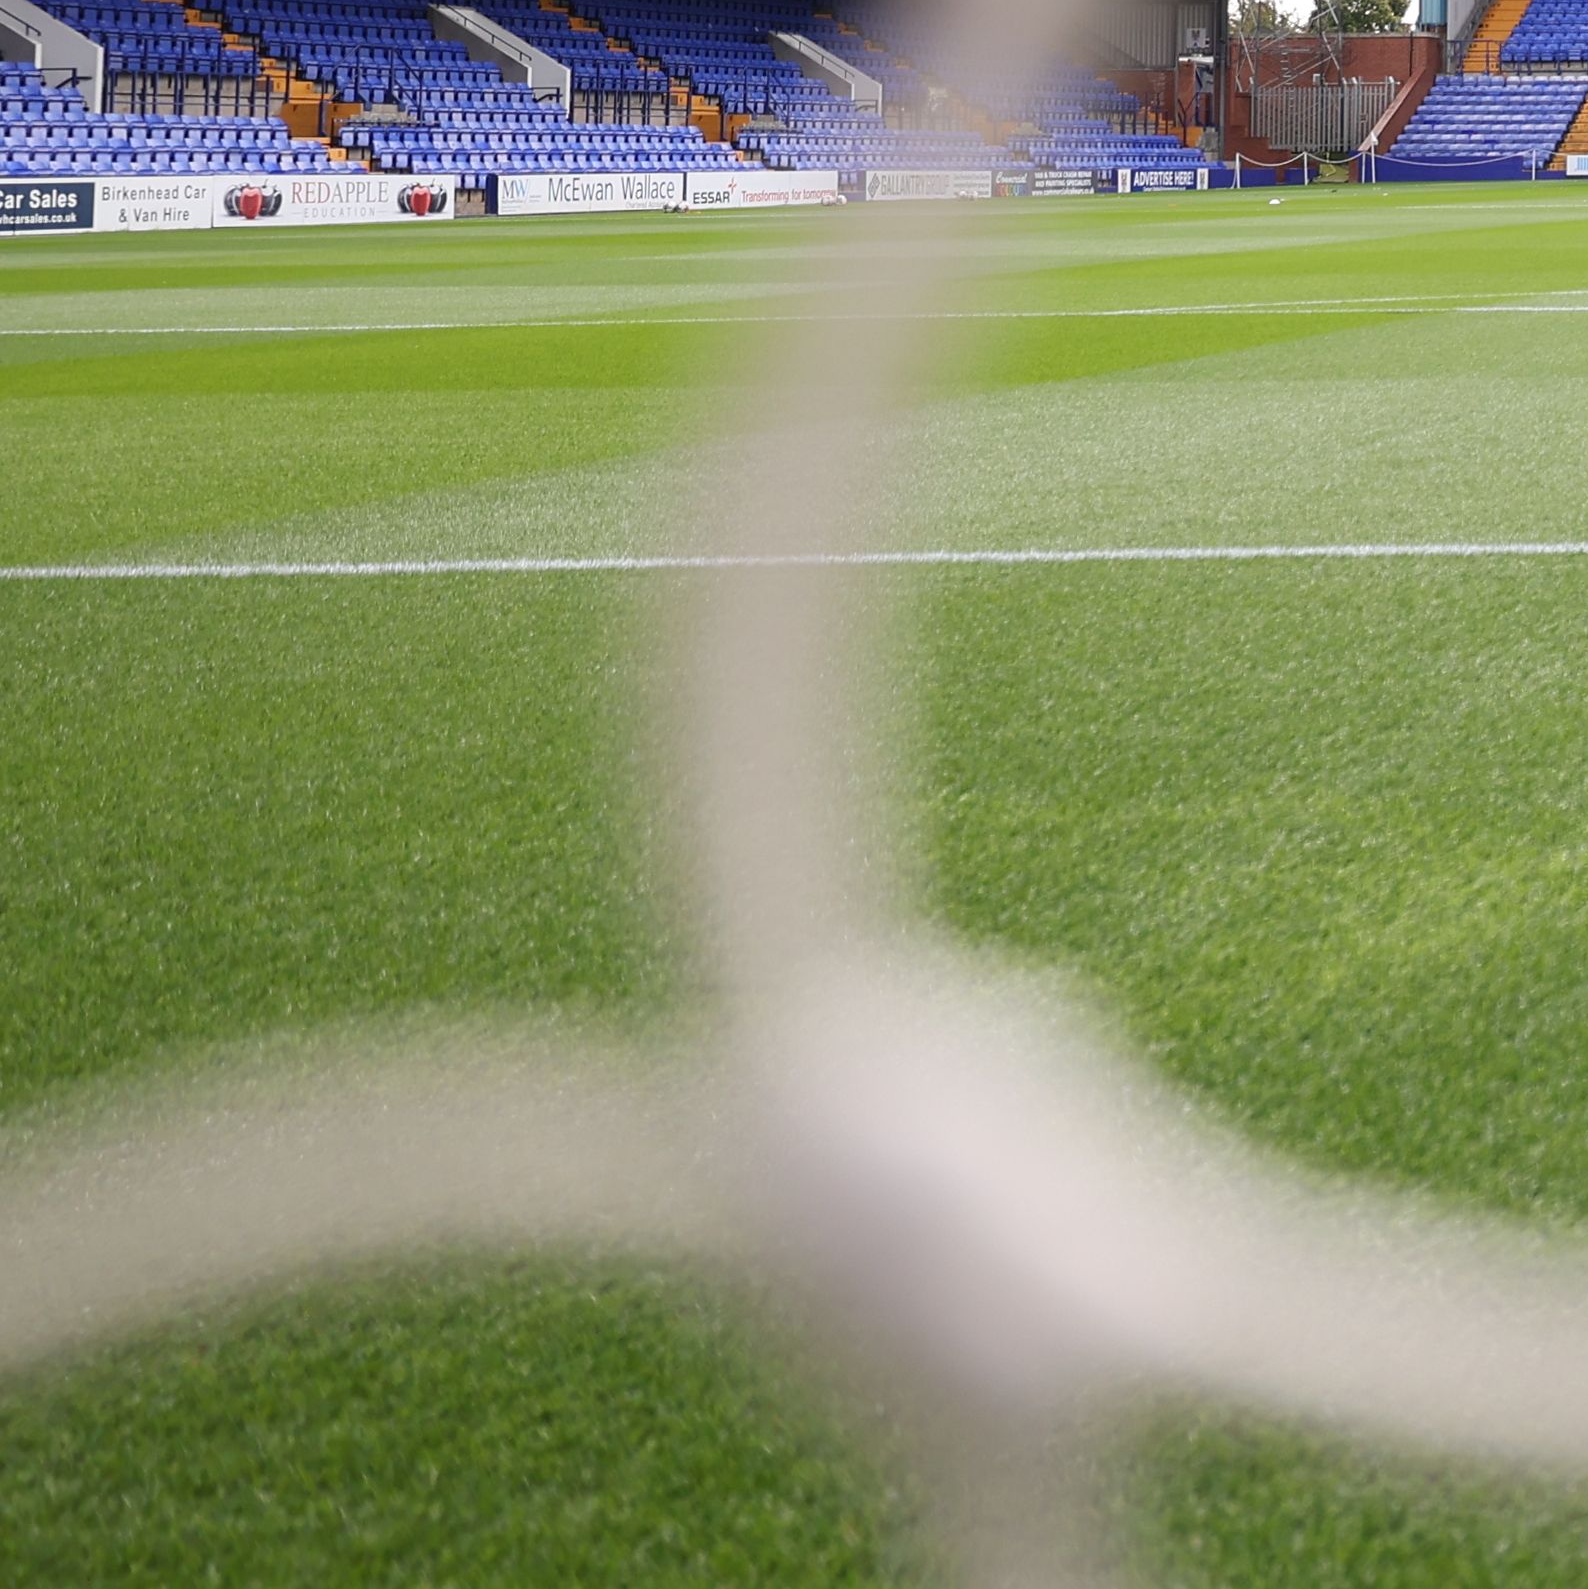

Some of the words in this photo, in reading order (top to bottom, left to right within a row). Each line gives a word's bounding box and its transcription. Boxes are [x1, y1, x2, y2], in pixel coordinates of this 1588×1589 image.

[881, 174, 925, 196] GALLANTRY
[1133, 171, 1173, 186] ADVERTISE
[1174, 170, 1194, 185] HERE!
[102, 185, 179, 202] Birkenhead
[184, 186, 207, 200] Car
[291, 181, 389, 205] REDAPPLE
[548, 176, 613, 203] McEwan
[621, 175, 675, 200] Wallace
[693, 192, 730, 204] ESSAR
[741, 190, 789, 205] Transforming
[791, 188, 801, 200] for
[29, 189, 78, 210] Sales
[118, 208, 127, 223] &
[133, 208, 158, 222] Van
[163, 208, 190, 222] Hire
[304, 206, 376, 219] EDUCATION
